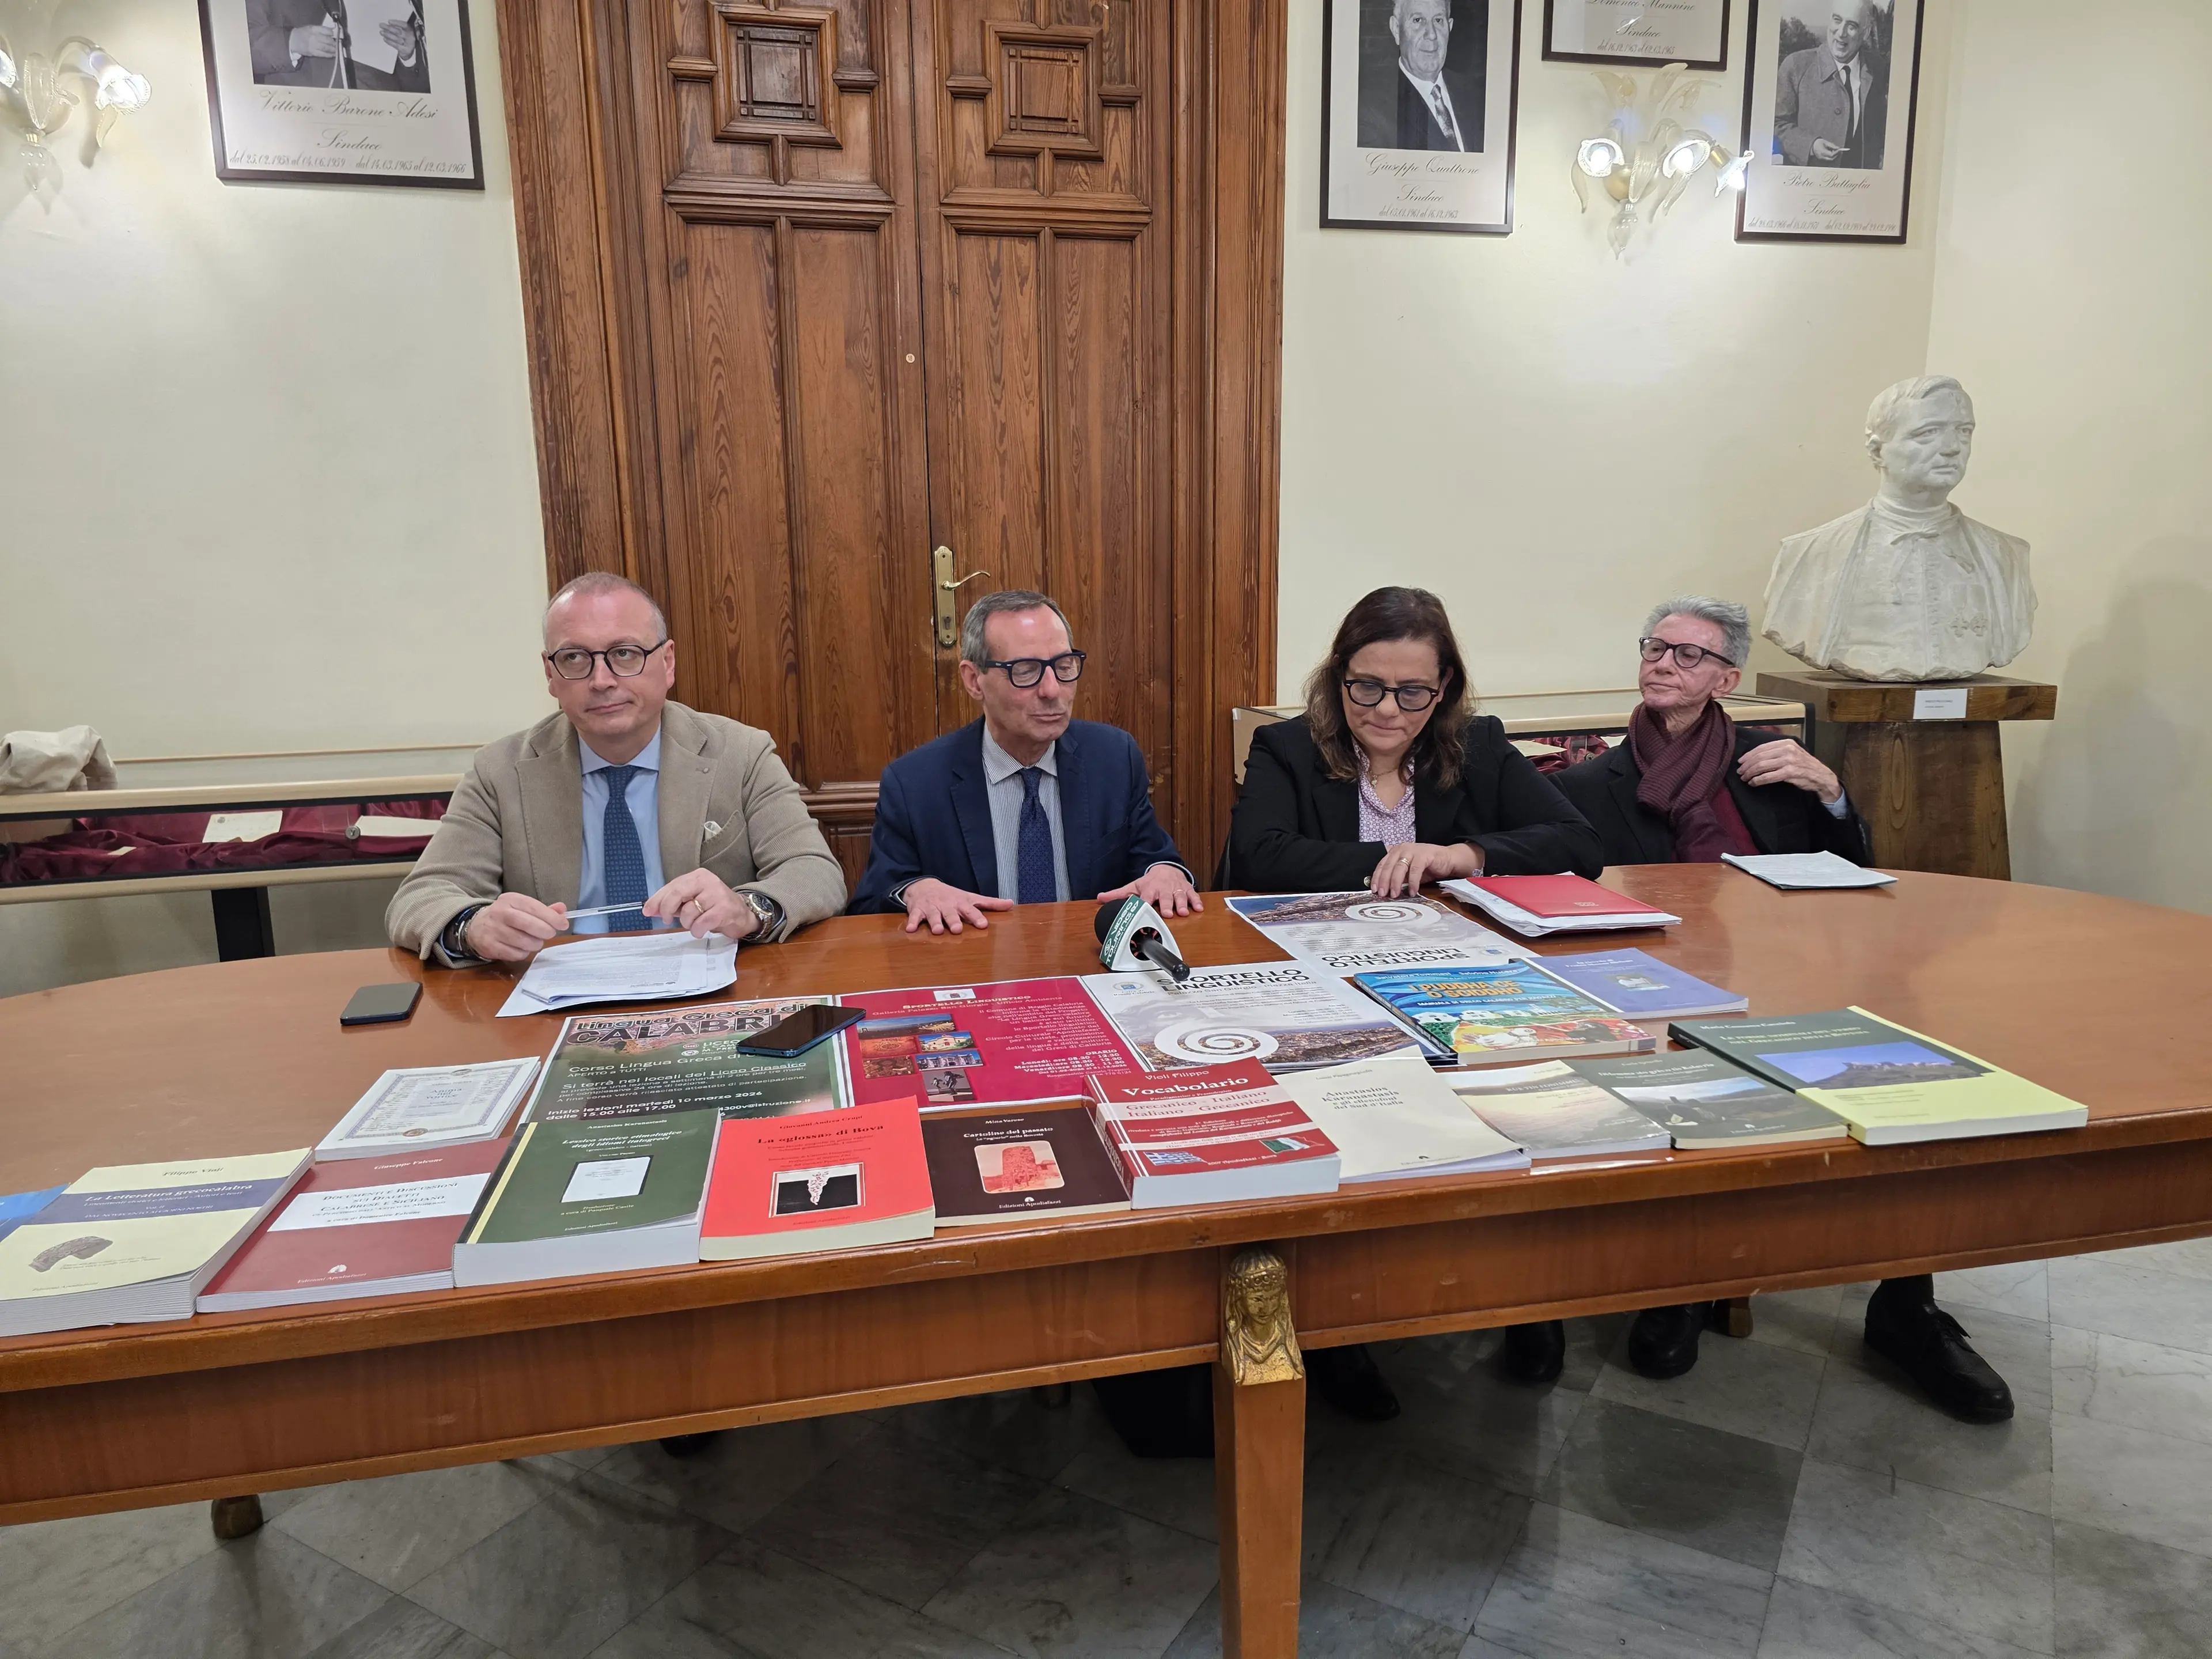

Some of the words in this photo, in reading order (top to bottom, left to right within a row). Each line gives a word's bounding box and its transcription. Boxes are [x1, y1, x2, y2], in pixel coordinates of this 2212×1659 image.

[1616, 19, 1661, 37] Sindaco
[259, 90, 313, 112] Vittorio
[322, 92, 385, 116] Barone
[389, 99, 438, 119] Adesi
[317, 128, 382, 150] Sindaco
[229, 150, 246, 163] dal
[291, 151, 304, 166] al
[356, 154, 373, 169] dal
[414, 157, 426, 171] al
[1366, 153, 1419, 176] Giuseppe
[1426, 155, 1479, 174] Quattrone
[1783, 171, 1813, 187] Pietro
[1820, 171, 1871, 192] Battaglia
[1397, 183, 1444, 202] Sindaco
[1804, 199, 1845, 215] Sindaco
[1162, 975, 1310, 991] LINGUISTICO
[1419, 980, 1492, 991] PUDDHA
[1446, 987, 1524, 998] SCIDDHO
[577, 1016, 672, 1031] Lingua
[681, 1006, 772, 1021] Greca
[779, 1003, 806, 1013] di
[566, 1014, 782, 1044] CALABRI
[569, 1065, 614, 1073] Corso
[620, 1060, 672, 1069] Lingua
[645, 1074, 680, 1082] locali
[710, 1068, 747, 1076] Liceo
[751, 1062, 806, 1072] Classico
[1172, 1070, 1210, 1078] Filippo
[1122, 1077, 1249, 1096] Vocabolario
[626, 1100, 673, 1108] martedì
[1126, 1101, 1197, 1111] Grecanico
[1213, 1091, 1267, 1103] Italiano
[1128, 1109, 1184, 1118] Italiano
[1198, 1098, 1270, 1112] Grecanico
[630, 1130, 683, 1139] etimologico
[104, 1191, 174, 1201] Letteratura
[174, 1184, 252, 1196] grecocalabra
[397, 1183, 459, 1192] DISCUSSIONI
